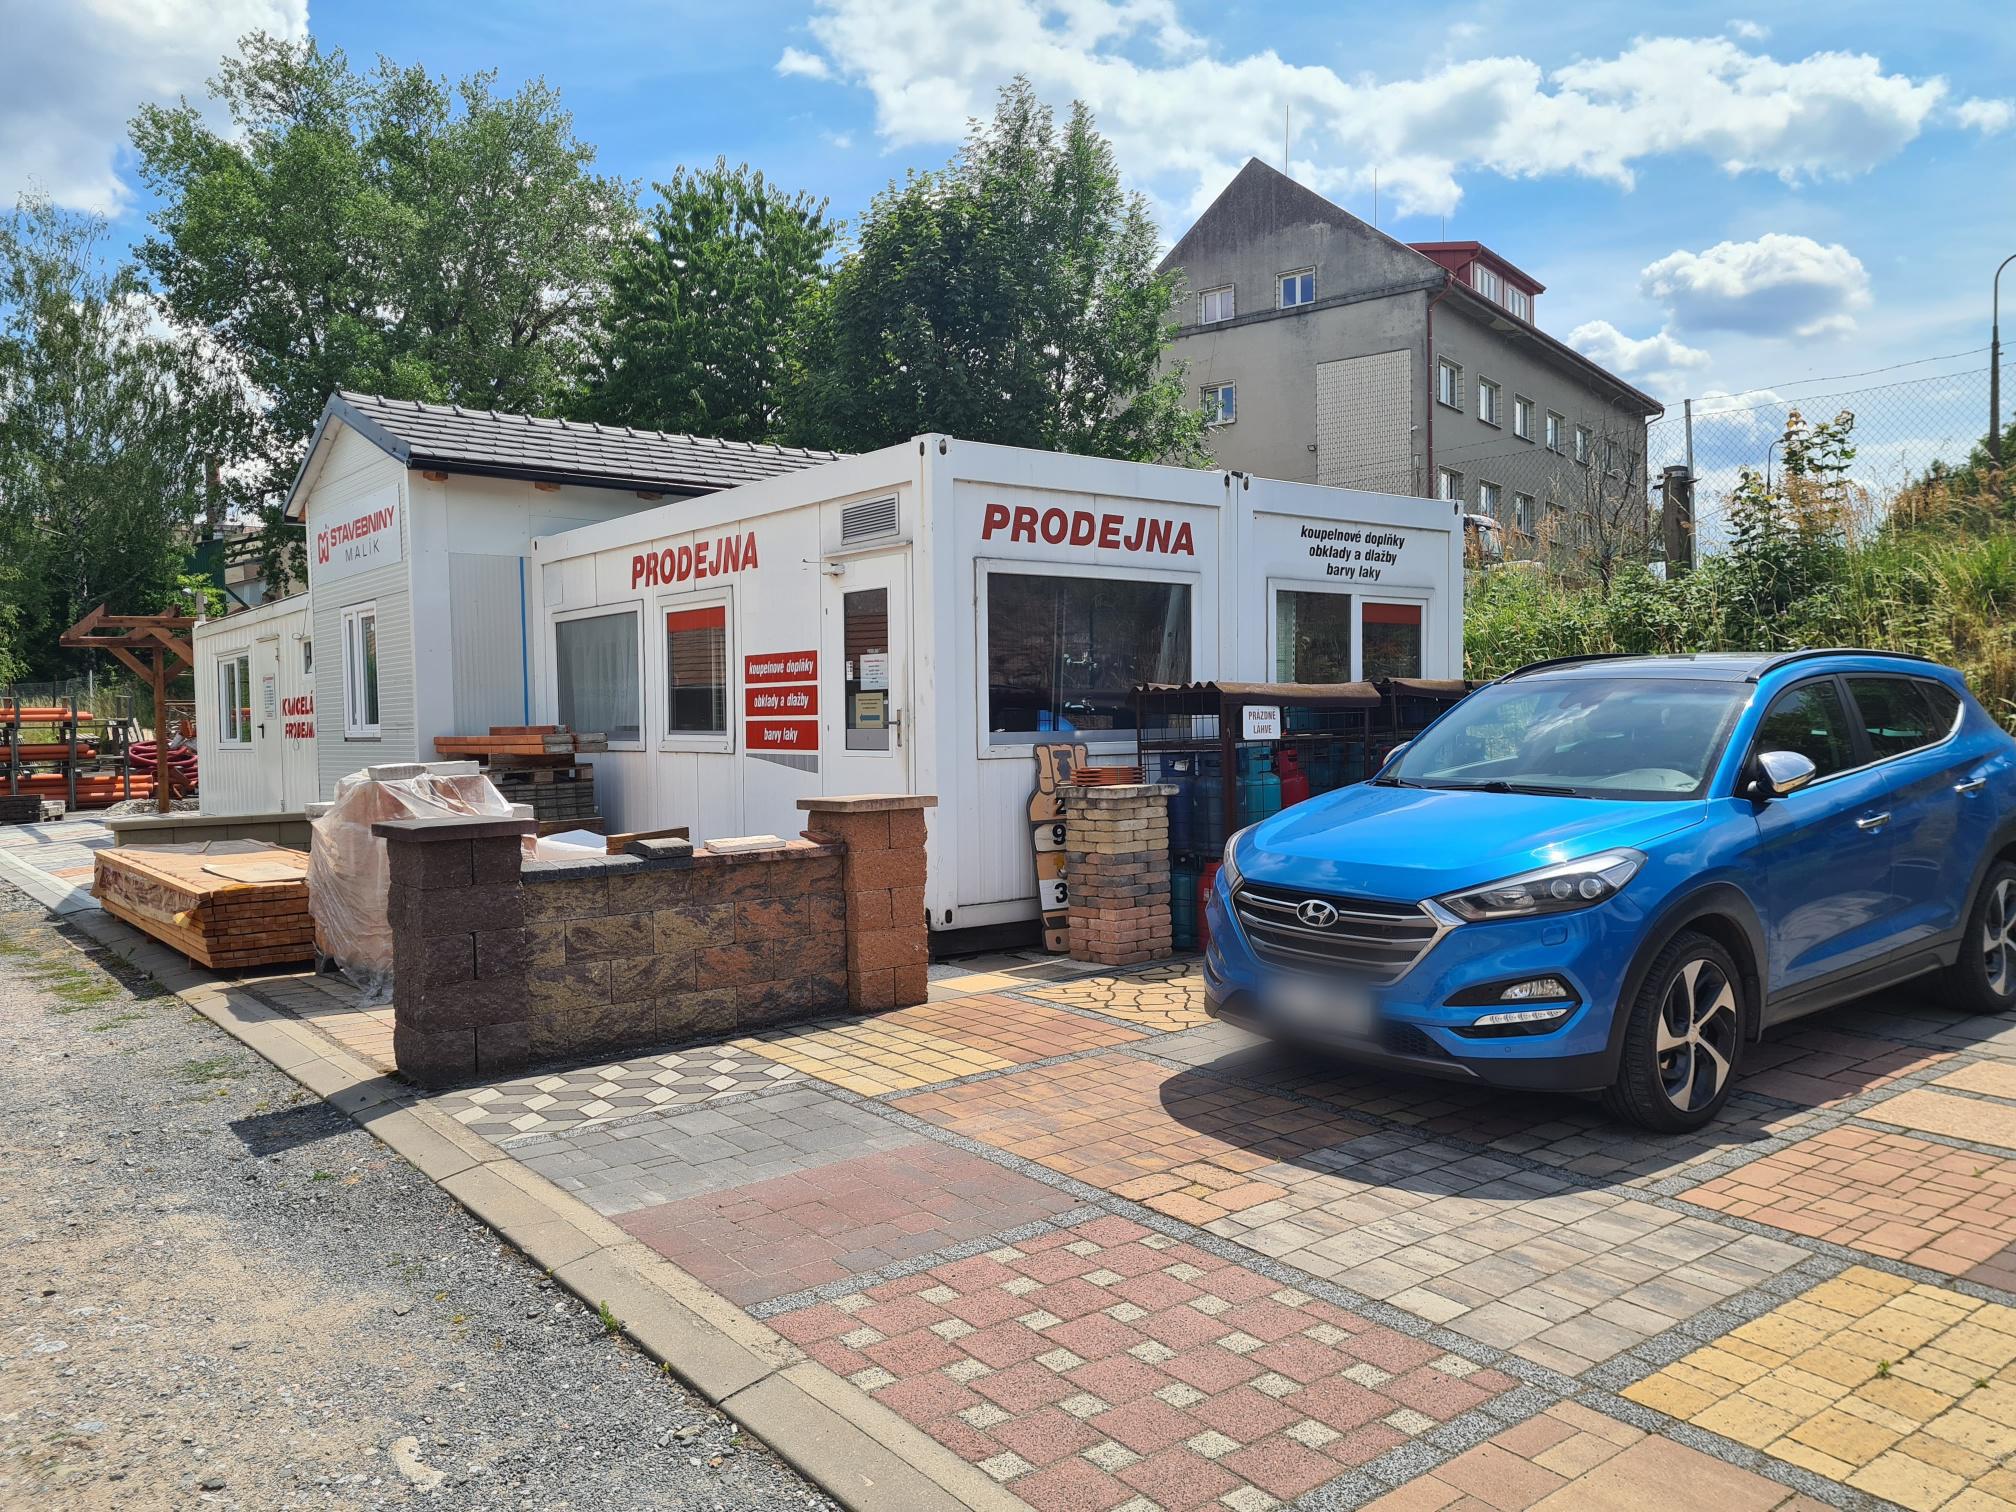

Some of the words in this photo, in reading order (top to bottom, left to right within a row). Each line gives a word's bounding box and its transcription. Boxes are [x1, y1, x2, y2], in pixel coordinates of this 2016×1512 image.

[330, 505, 394, 547] STAVEBNINY
[981, 503, 1195, 556] PRODEJNA
[1300, 525, 1361, 543] koupelnové
[1364, 532, 1405, 549] doplňky
[345, 538, 380, 562] MALÍK
[631, 531, 758, 590] PRODEJNA
[1309, 544, 1352, 562] obklady
[1354, 550, 1361, 561] a
[1364, 549, 1398, 566] dlažby
[1326, 563, 1356, 579] barvy
[1358, 565, 1381, 581] laky
[748, 660, 785, 677] koupelnové
[786, 658, 814, 675] doplňky
[754, 694, 779, 709] obklady
[780, 696, 785, 706] a
[786, 692, 809, 709] dlažby
[285, 721, 315, 739] PRODEJN
[763, 727, 782, 743] barvy
[783, 727, 798, 743] laky
[1253, 722, 1272, 734] LÁHVE
[1052, 823, 1067, 845] 9
[1054, 882, 1068, 904] 3
